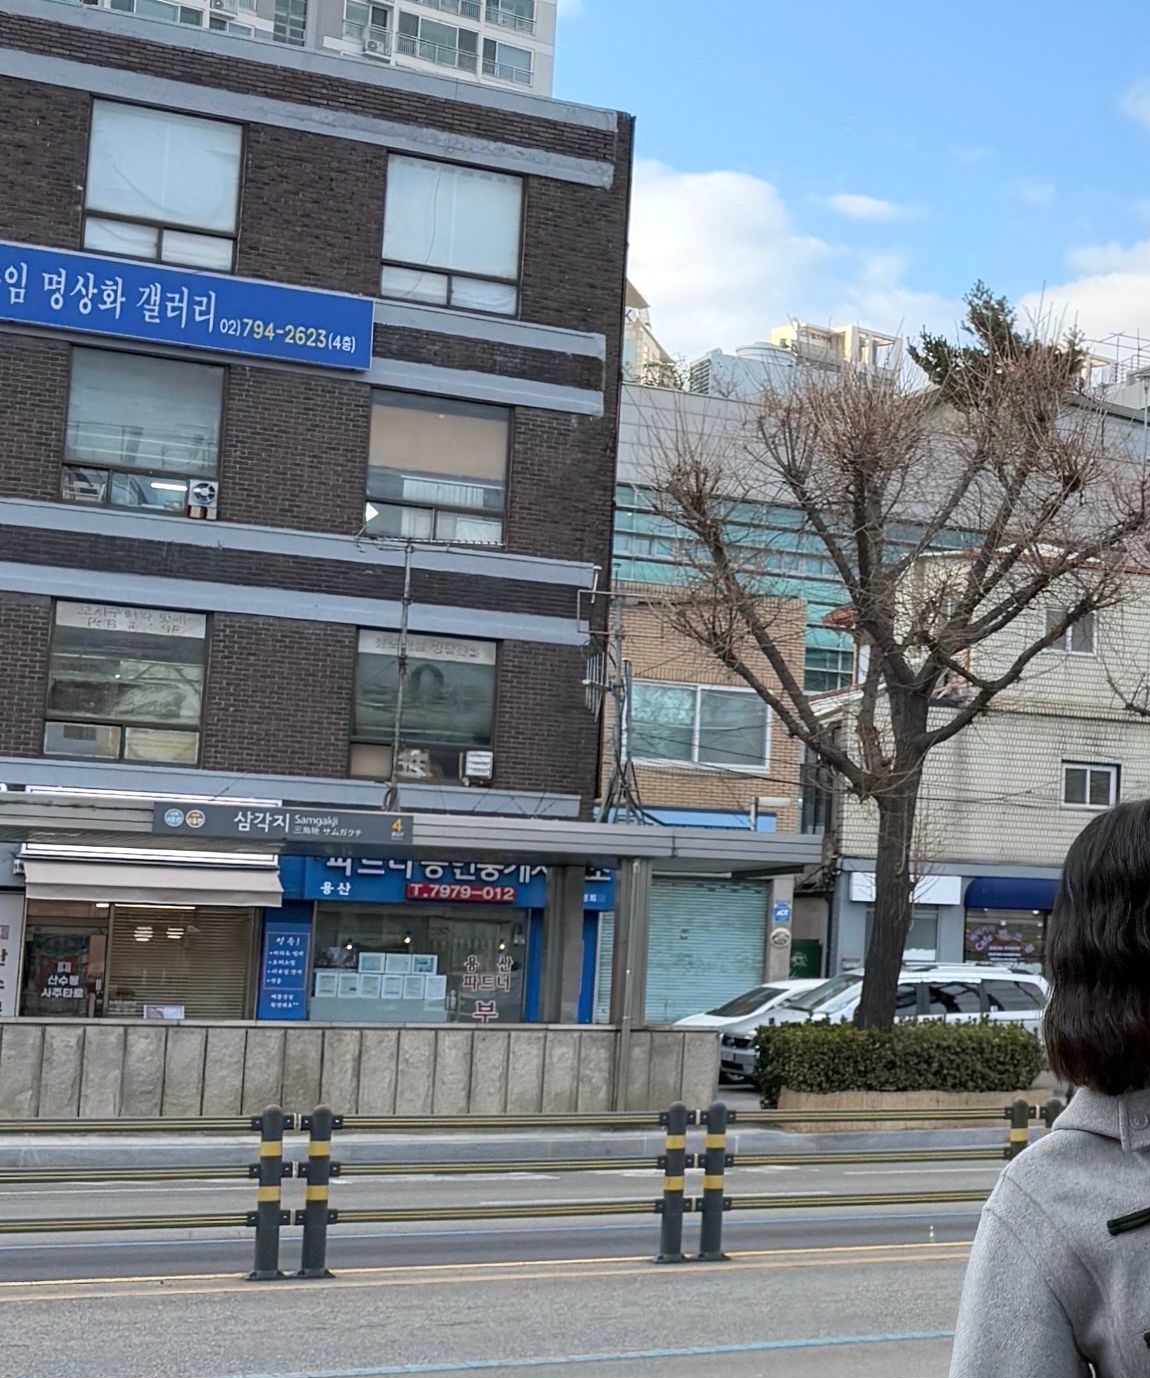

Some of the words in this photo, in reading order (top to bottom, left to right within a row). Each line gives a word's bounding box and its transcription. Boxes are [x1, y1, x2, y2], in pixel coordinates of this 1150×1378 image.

[0, 262, 28, 305] 임
[42, 268, 126, 320] 명상화
[136, 283, 216, 333] 갤러리
[219, 318, 327, 348] 02)794-2623
[234, 811, 290, 833] 삼각지
[294, 815, 338, 828] Samgakji
[391, 818, 402, 832] 4
[320, 881, 351, 896] 용산
[410, 883, 515, 900] T.7979-012
[462, 973, 511, 993] 파트너
